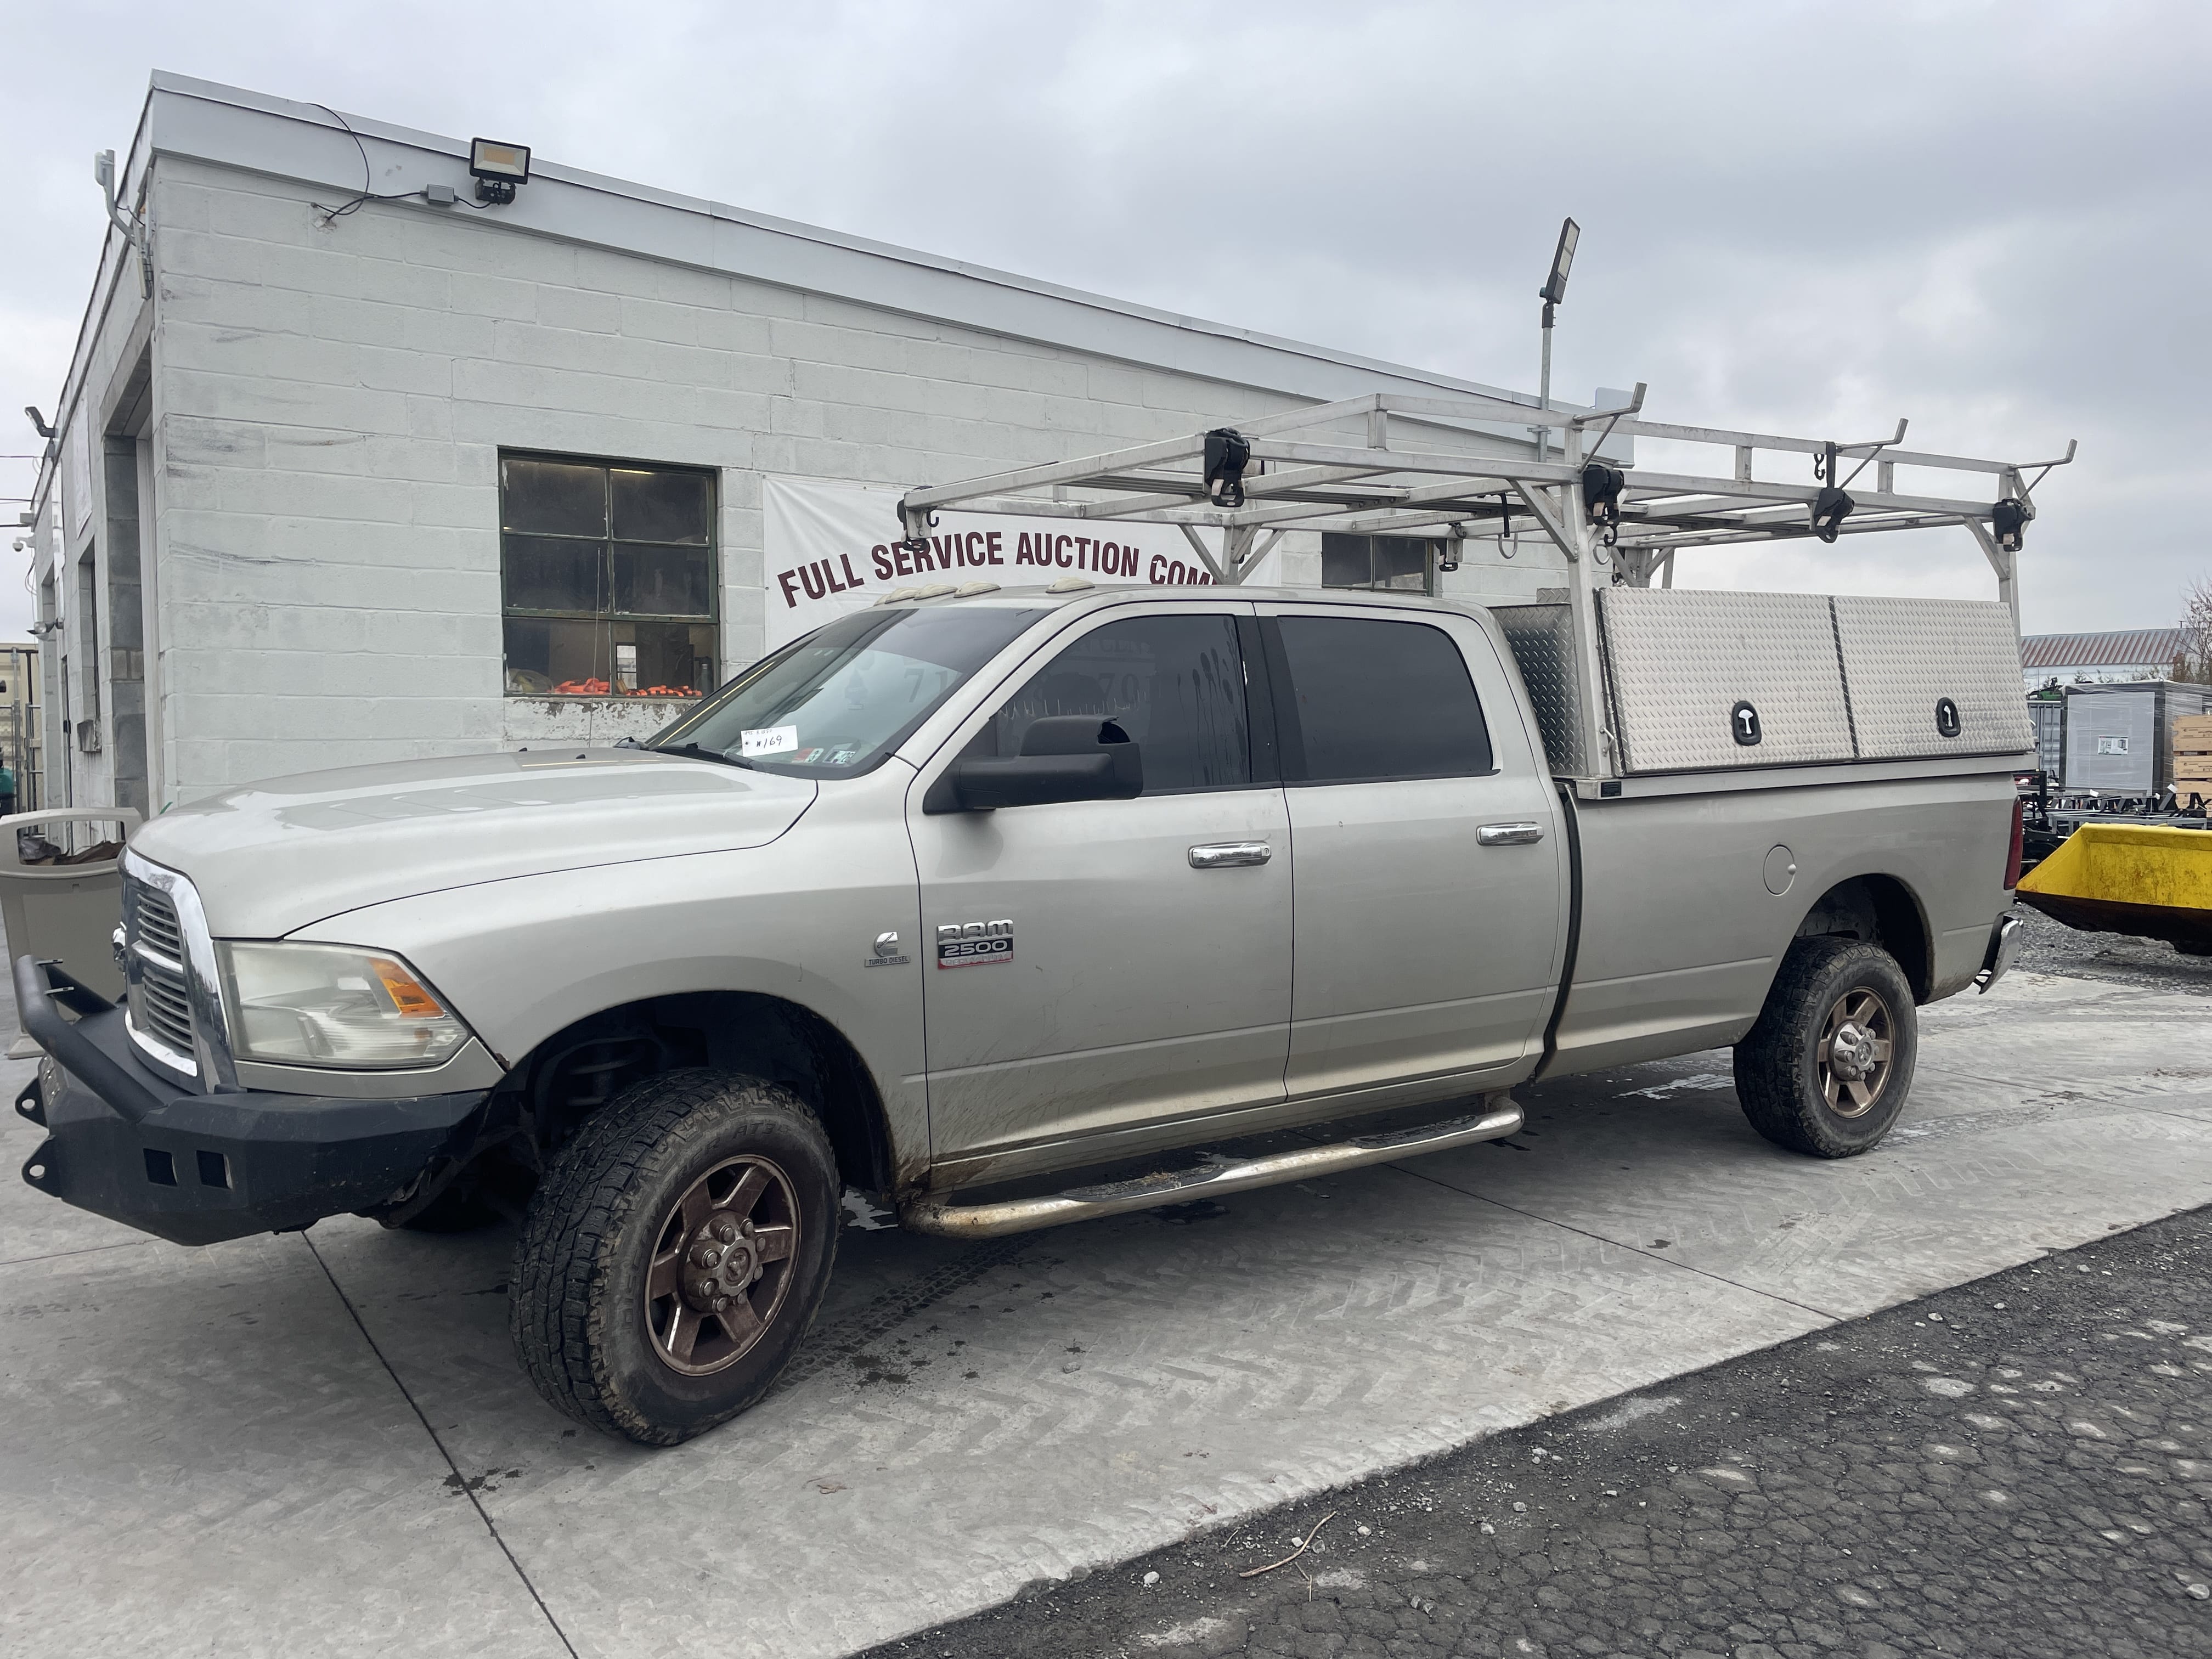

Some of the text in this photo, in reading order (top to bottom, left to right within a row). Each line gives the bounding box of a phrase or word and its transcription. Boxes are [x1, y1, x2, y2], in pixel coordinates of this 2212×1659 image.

[777, 532, 1218, 608] FULL SERVICE AUCTION COM
[877, 933, 895, 949] Cummins
[937, 919, 1014, 943] RAM
[944, 940, 1008, 957] 2500
